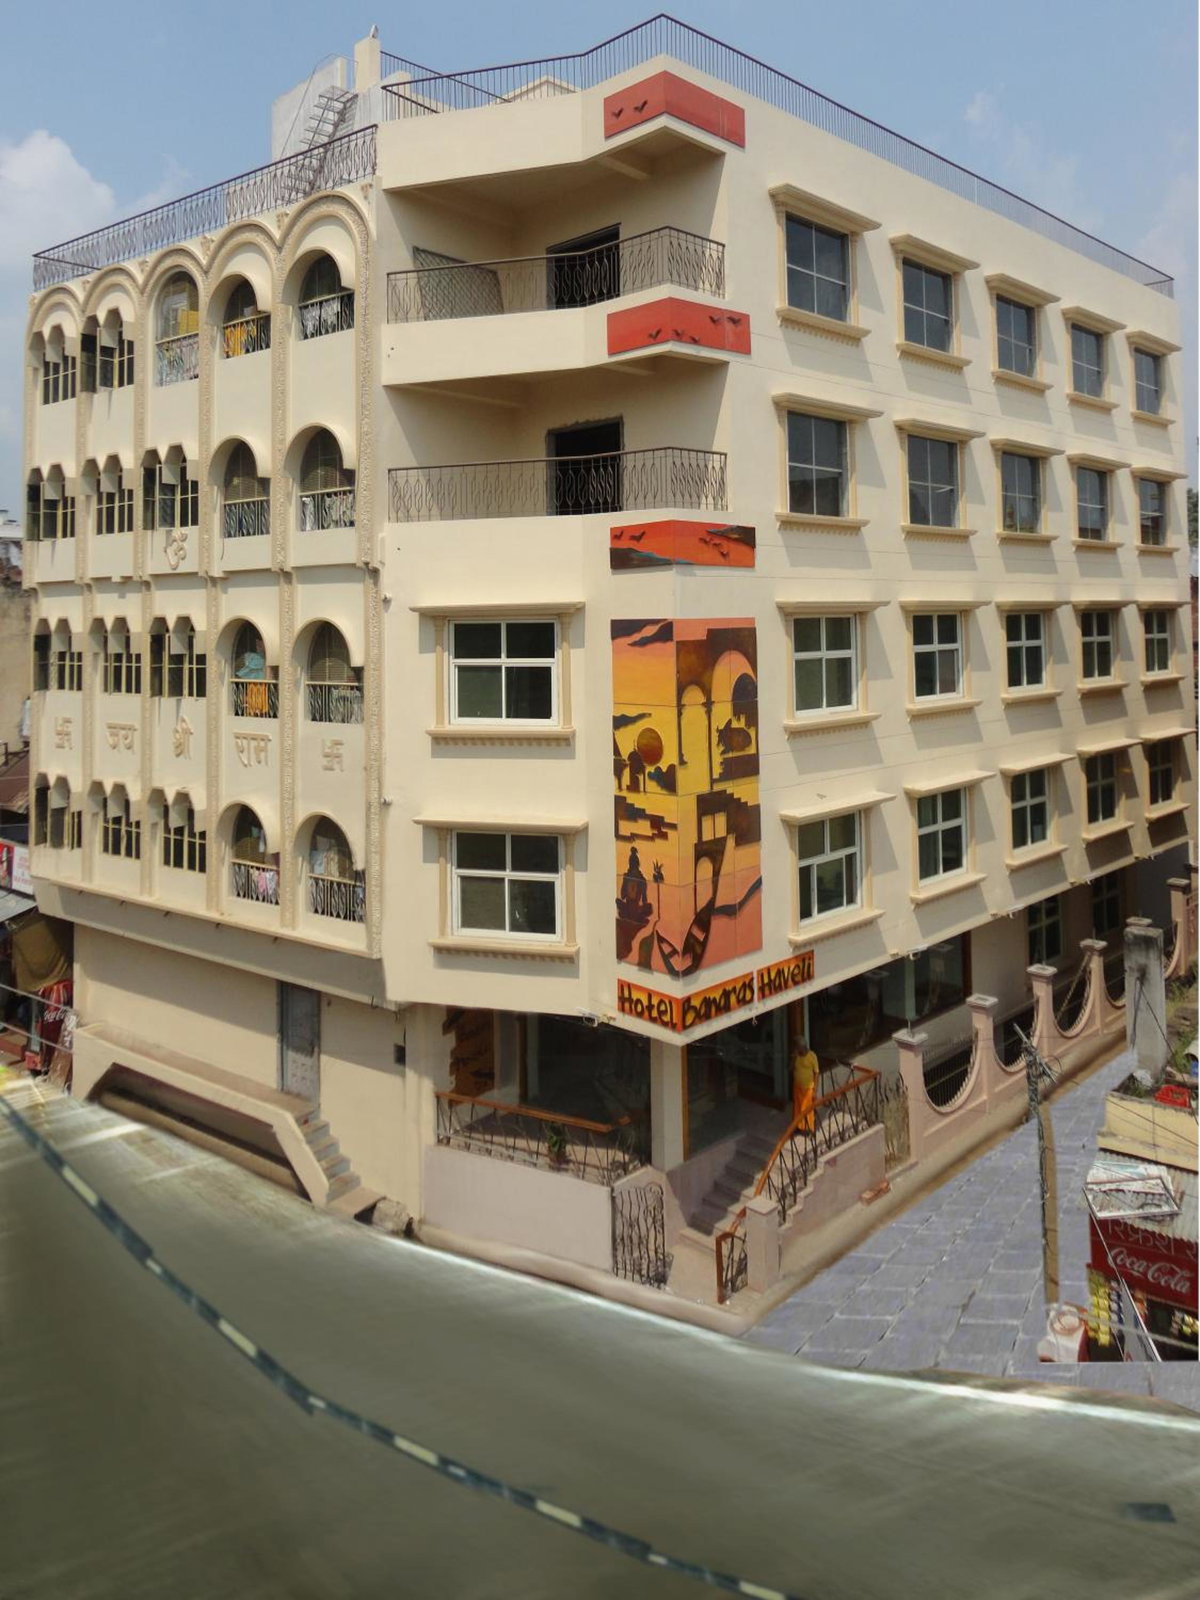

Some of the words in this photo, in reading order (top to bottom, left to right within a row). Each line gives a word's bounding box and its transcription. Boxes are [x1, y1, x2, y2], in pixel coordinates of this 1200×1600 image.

[232, 729, 273, 768] राम
[619, 983, 677, 1030] Hotel
[682, 976, 754, 1030] Banaras
[758, 957, 812, 998] Haveli
